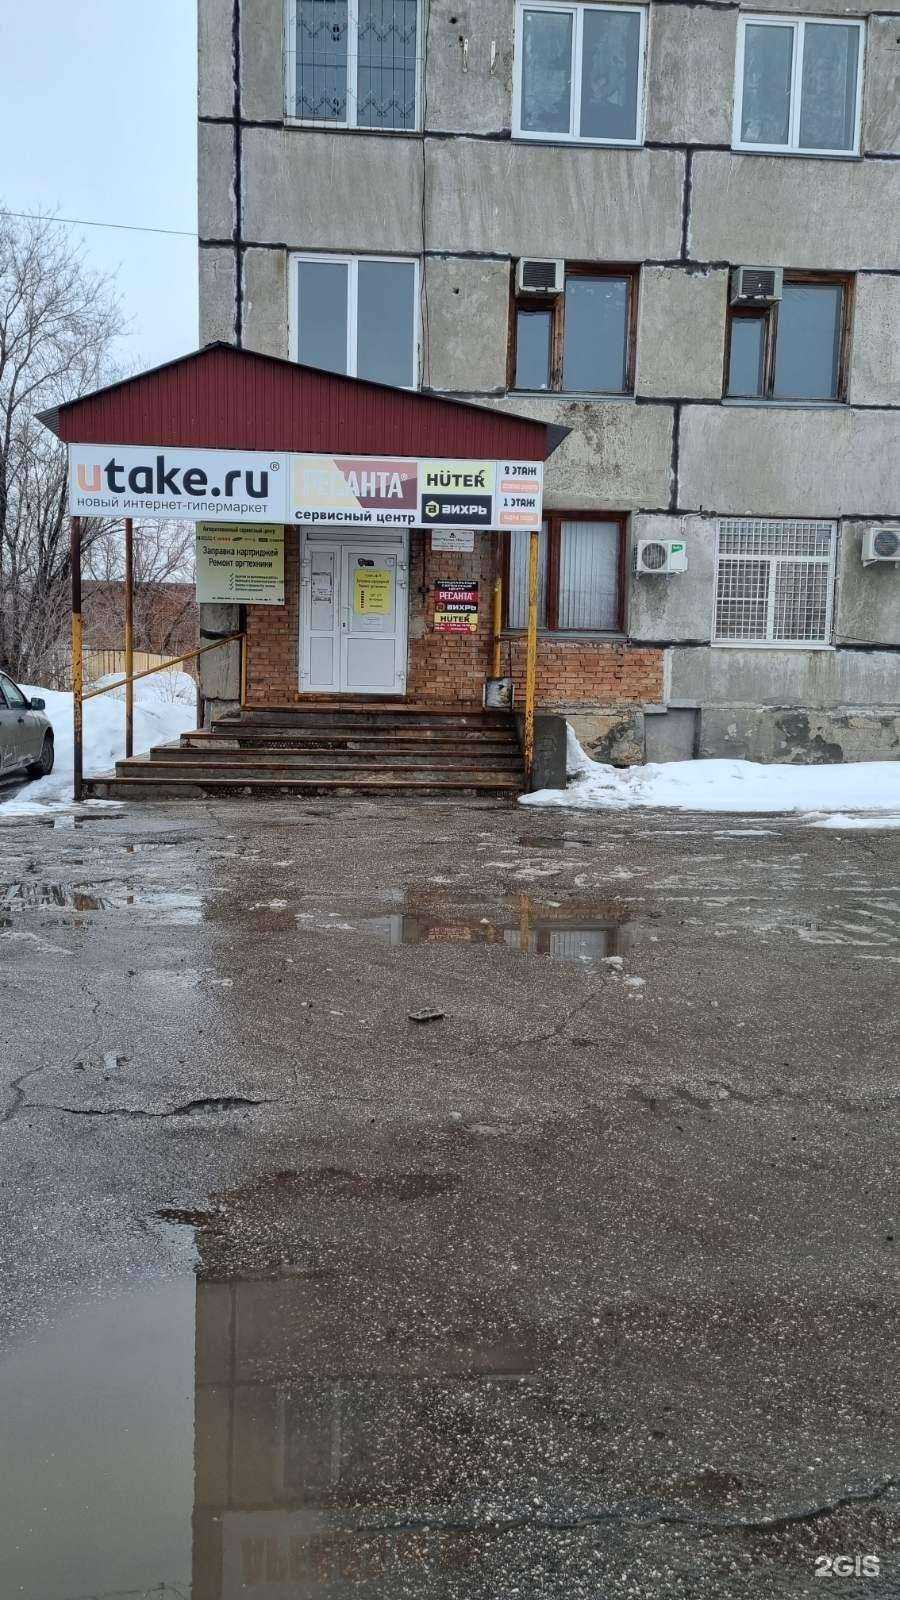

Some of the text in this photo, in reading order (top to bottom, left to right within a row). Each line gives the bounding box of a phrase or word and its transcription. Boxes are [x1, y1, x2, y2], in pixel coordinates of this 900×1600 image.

[512, 466, 537, 476] ЭТАЖ
[77, 455, 269, 499] utake.ru
[77, 497, 268, 514] новый интернет-гипермаркет
[511, 498, 536, 507] ЭТАЖ
[441, 504, 488, 515] ВИХРЬ
[294, 510, 416, 526] сервисный центр
[202, 545, 235, 556] Заправка
[208, 558, 273, 568] Ремонт оргтехники
[439, 591, 473, 601] РЕСАНТА
